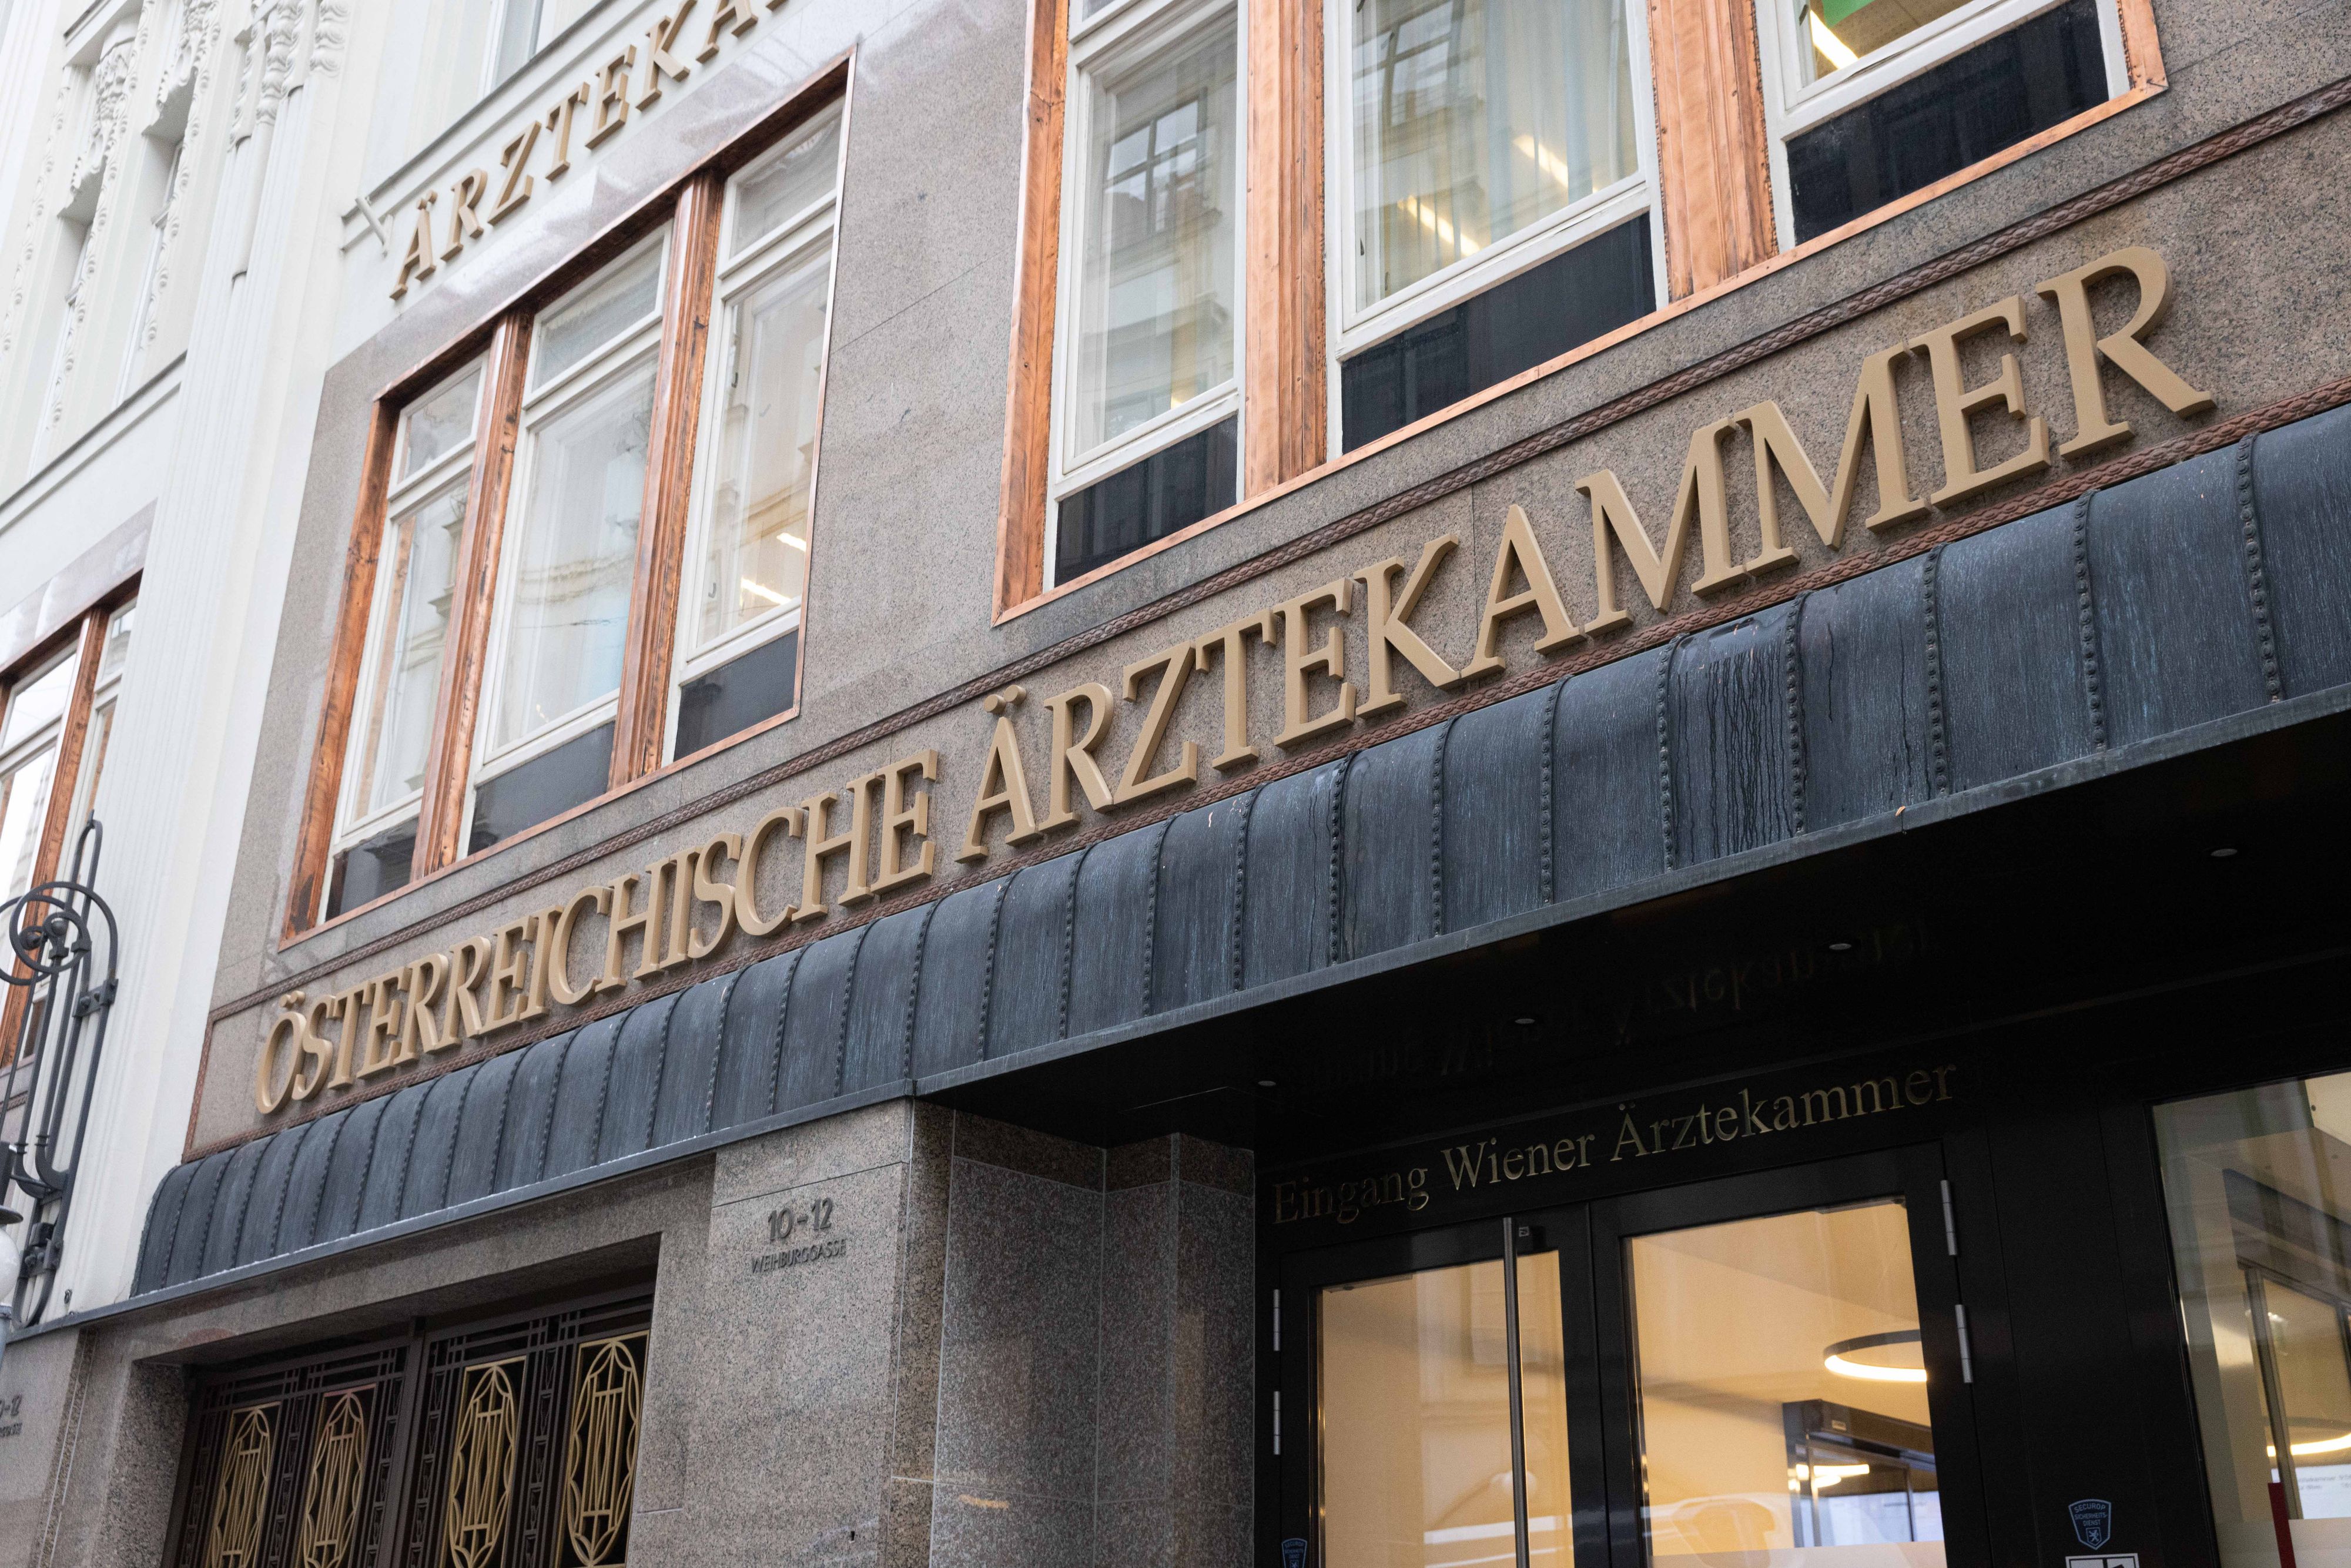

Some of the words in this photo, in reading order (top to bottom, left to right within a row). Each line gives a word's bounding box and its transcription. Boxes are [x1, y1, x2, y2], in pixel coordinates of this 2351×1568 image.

[389, 0, 789, 301] ÄRZTEKA
[255, 748, 939, 1115] ÖSTERREICHISCHE
[955, 246, 2218, 865] ÄRZTEKAMMER
[1271, 1166, 1429, 1225] Eingang
[1441, 1132, 1596, 1192] Wiener
[1610, 1062, 1957, 1162] Ärztekammer
[751, 1238, 847, 1274] WEIHBURGGASSE
[768, 1197, 833, 1241] 10-12
[2074, 1503, 2106, 1513] SECUROP
